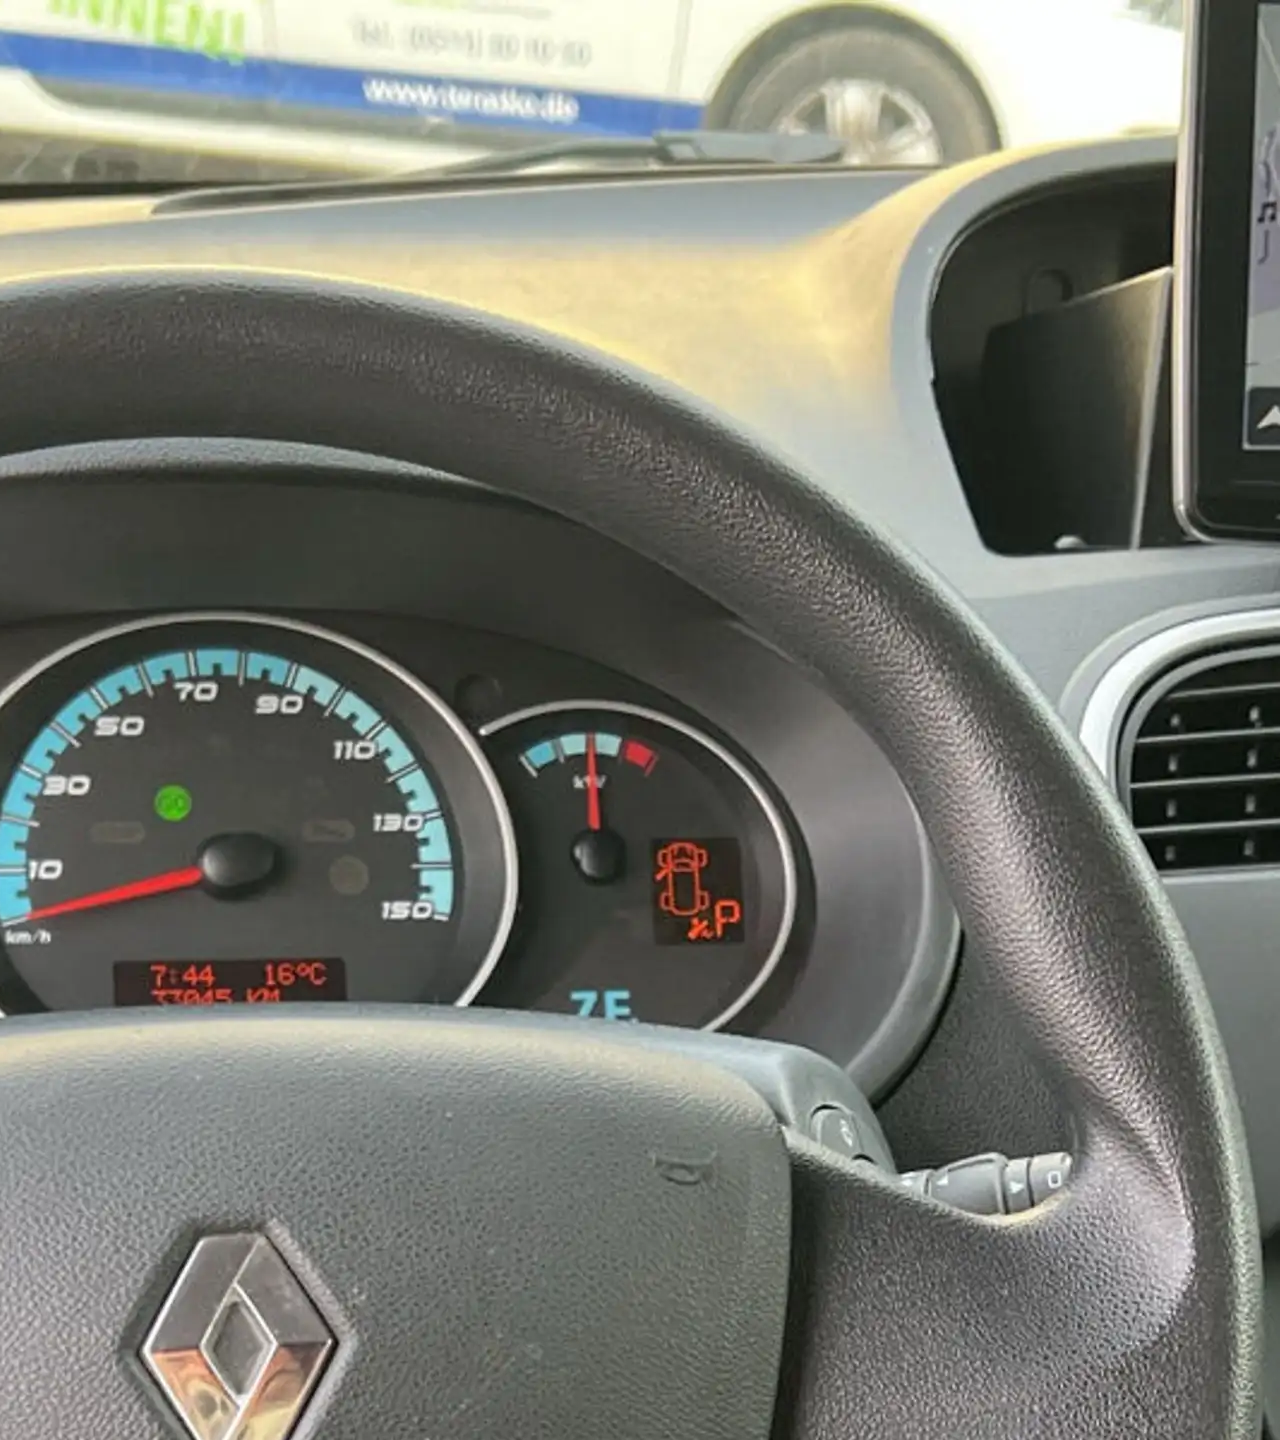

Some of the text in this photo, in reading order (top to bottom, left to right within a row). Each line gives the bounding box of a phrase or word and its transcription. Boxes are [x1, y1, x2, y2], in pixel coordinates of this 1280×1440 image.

[173, 681, 219, 702] 70
[254, 694, 305, 715] 90
[94, 716, 145, 737] 50
[332, 740, 377, 761] 110
[42, 775, 92, 796] 30
[372, 813, 424, 832] 130
[28, 859, 64, 880] 10
[381, 901, 434, 920] 150
[714, 899, 742, 937] P
[4, 929, 52, 944] km/h
[150, 964, 216, 987] 7:44
